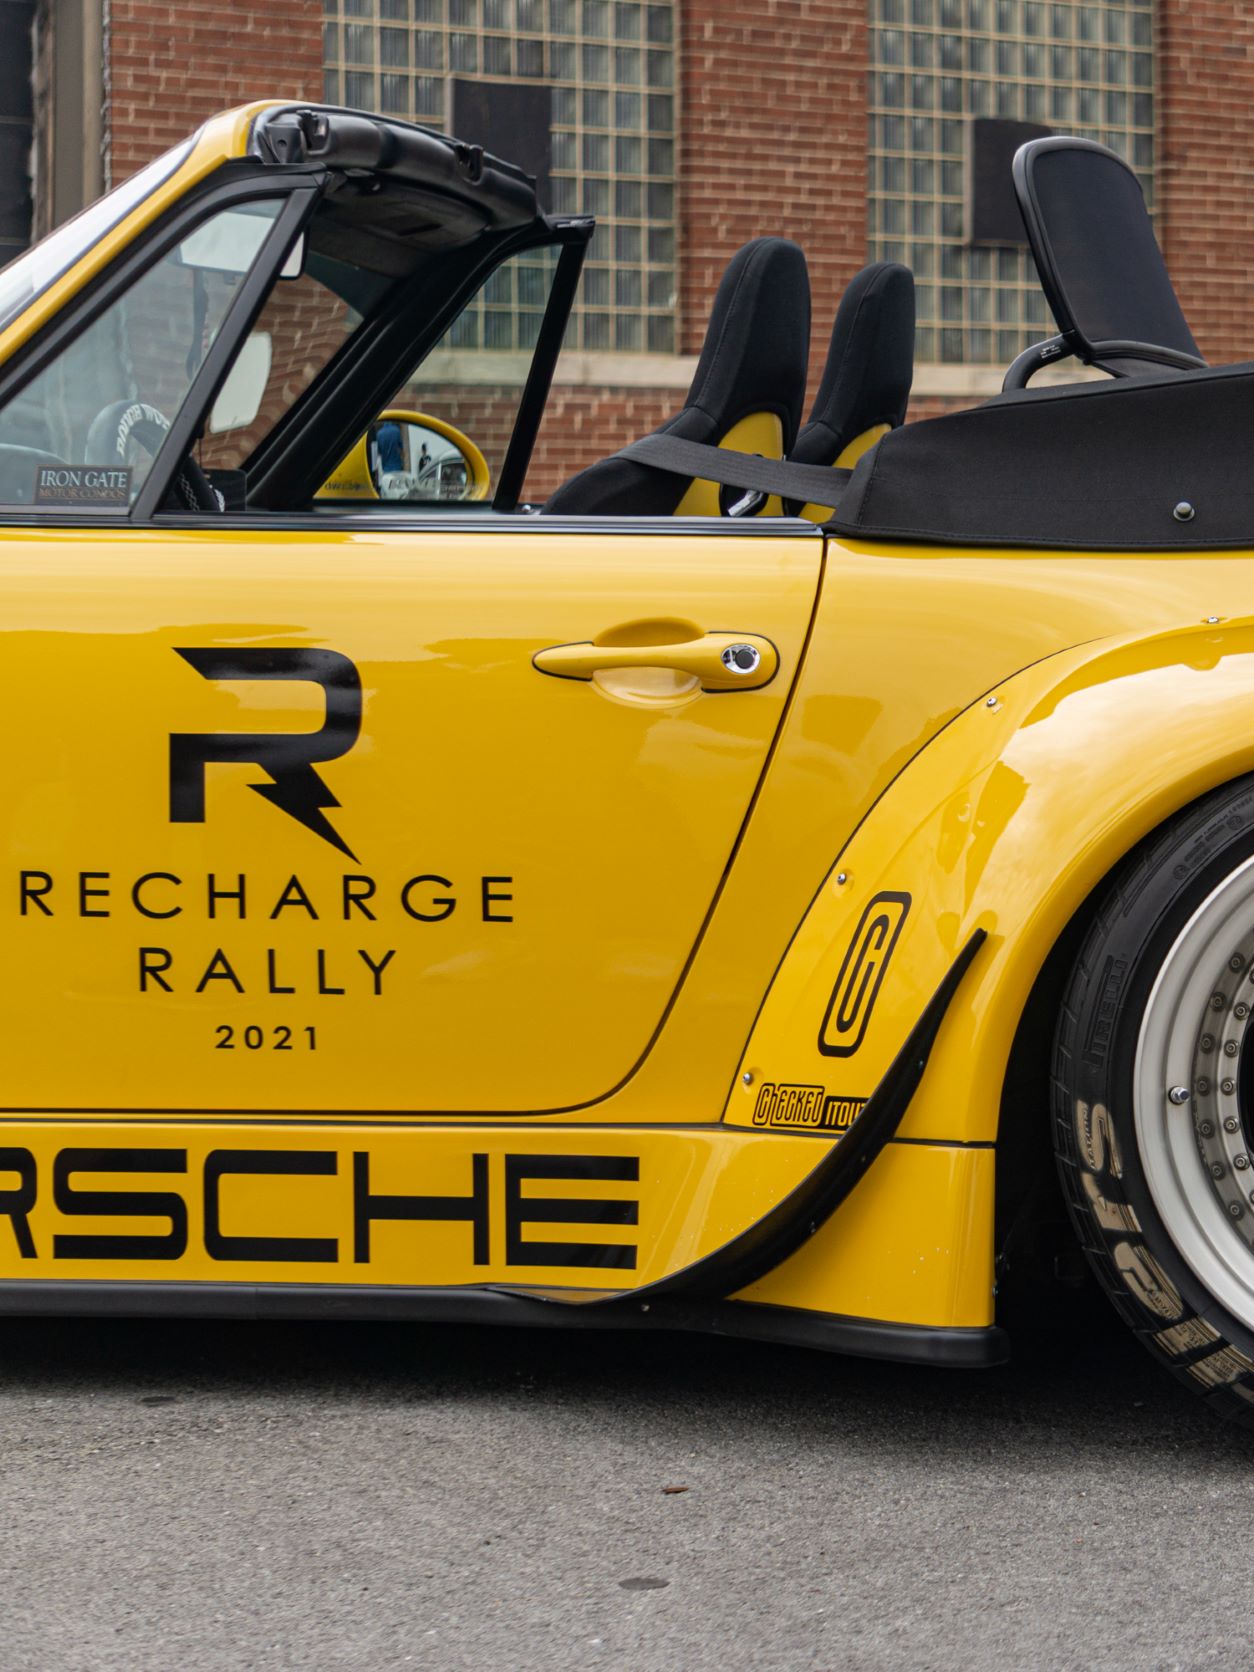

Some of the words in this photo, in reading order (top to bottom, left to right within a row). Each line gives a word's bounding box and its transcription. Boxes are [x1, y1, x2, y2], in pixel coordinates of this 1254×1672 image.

[40, 470, 81, 487] IRON
[84, 471, 128, 488] GATE
[20, 871, 513, 922] RECHARGE
[139, 948, 396, 995] RALLY
[1080, 955, 1129, 1068] PIRELLI
[215, 1025, 317, 1050] 2021
[0, 1147, 640, 1270] SCHE
